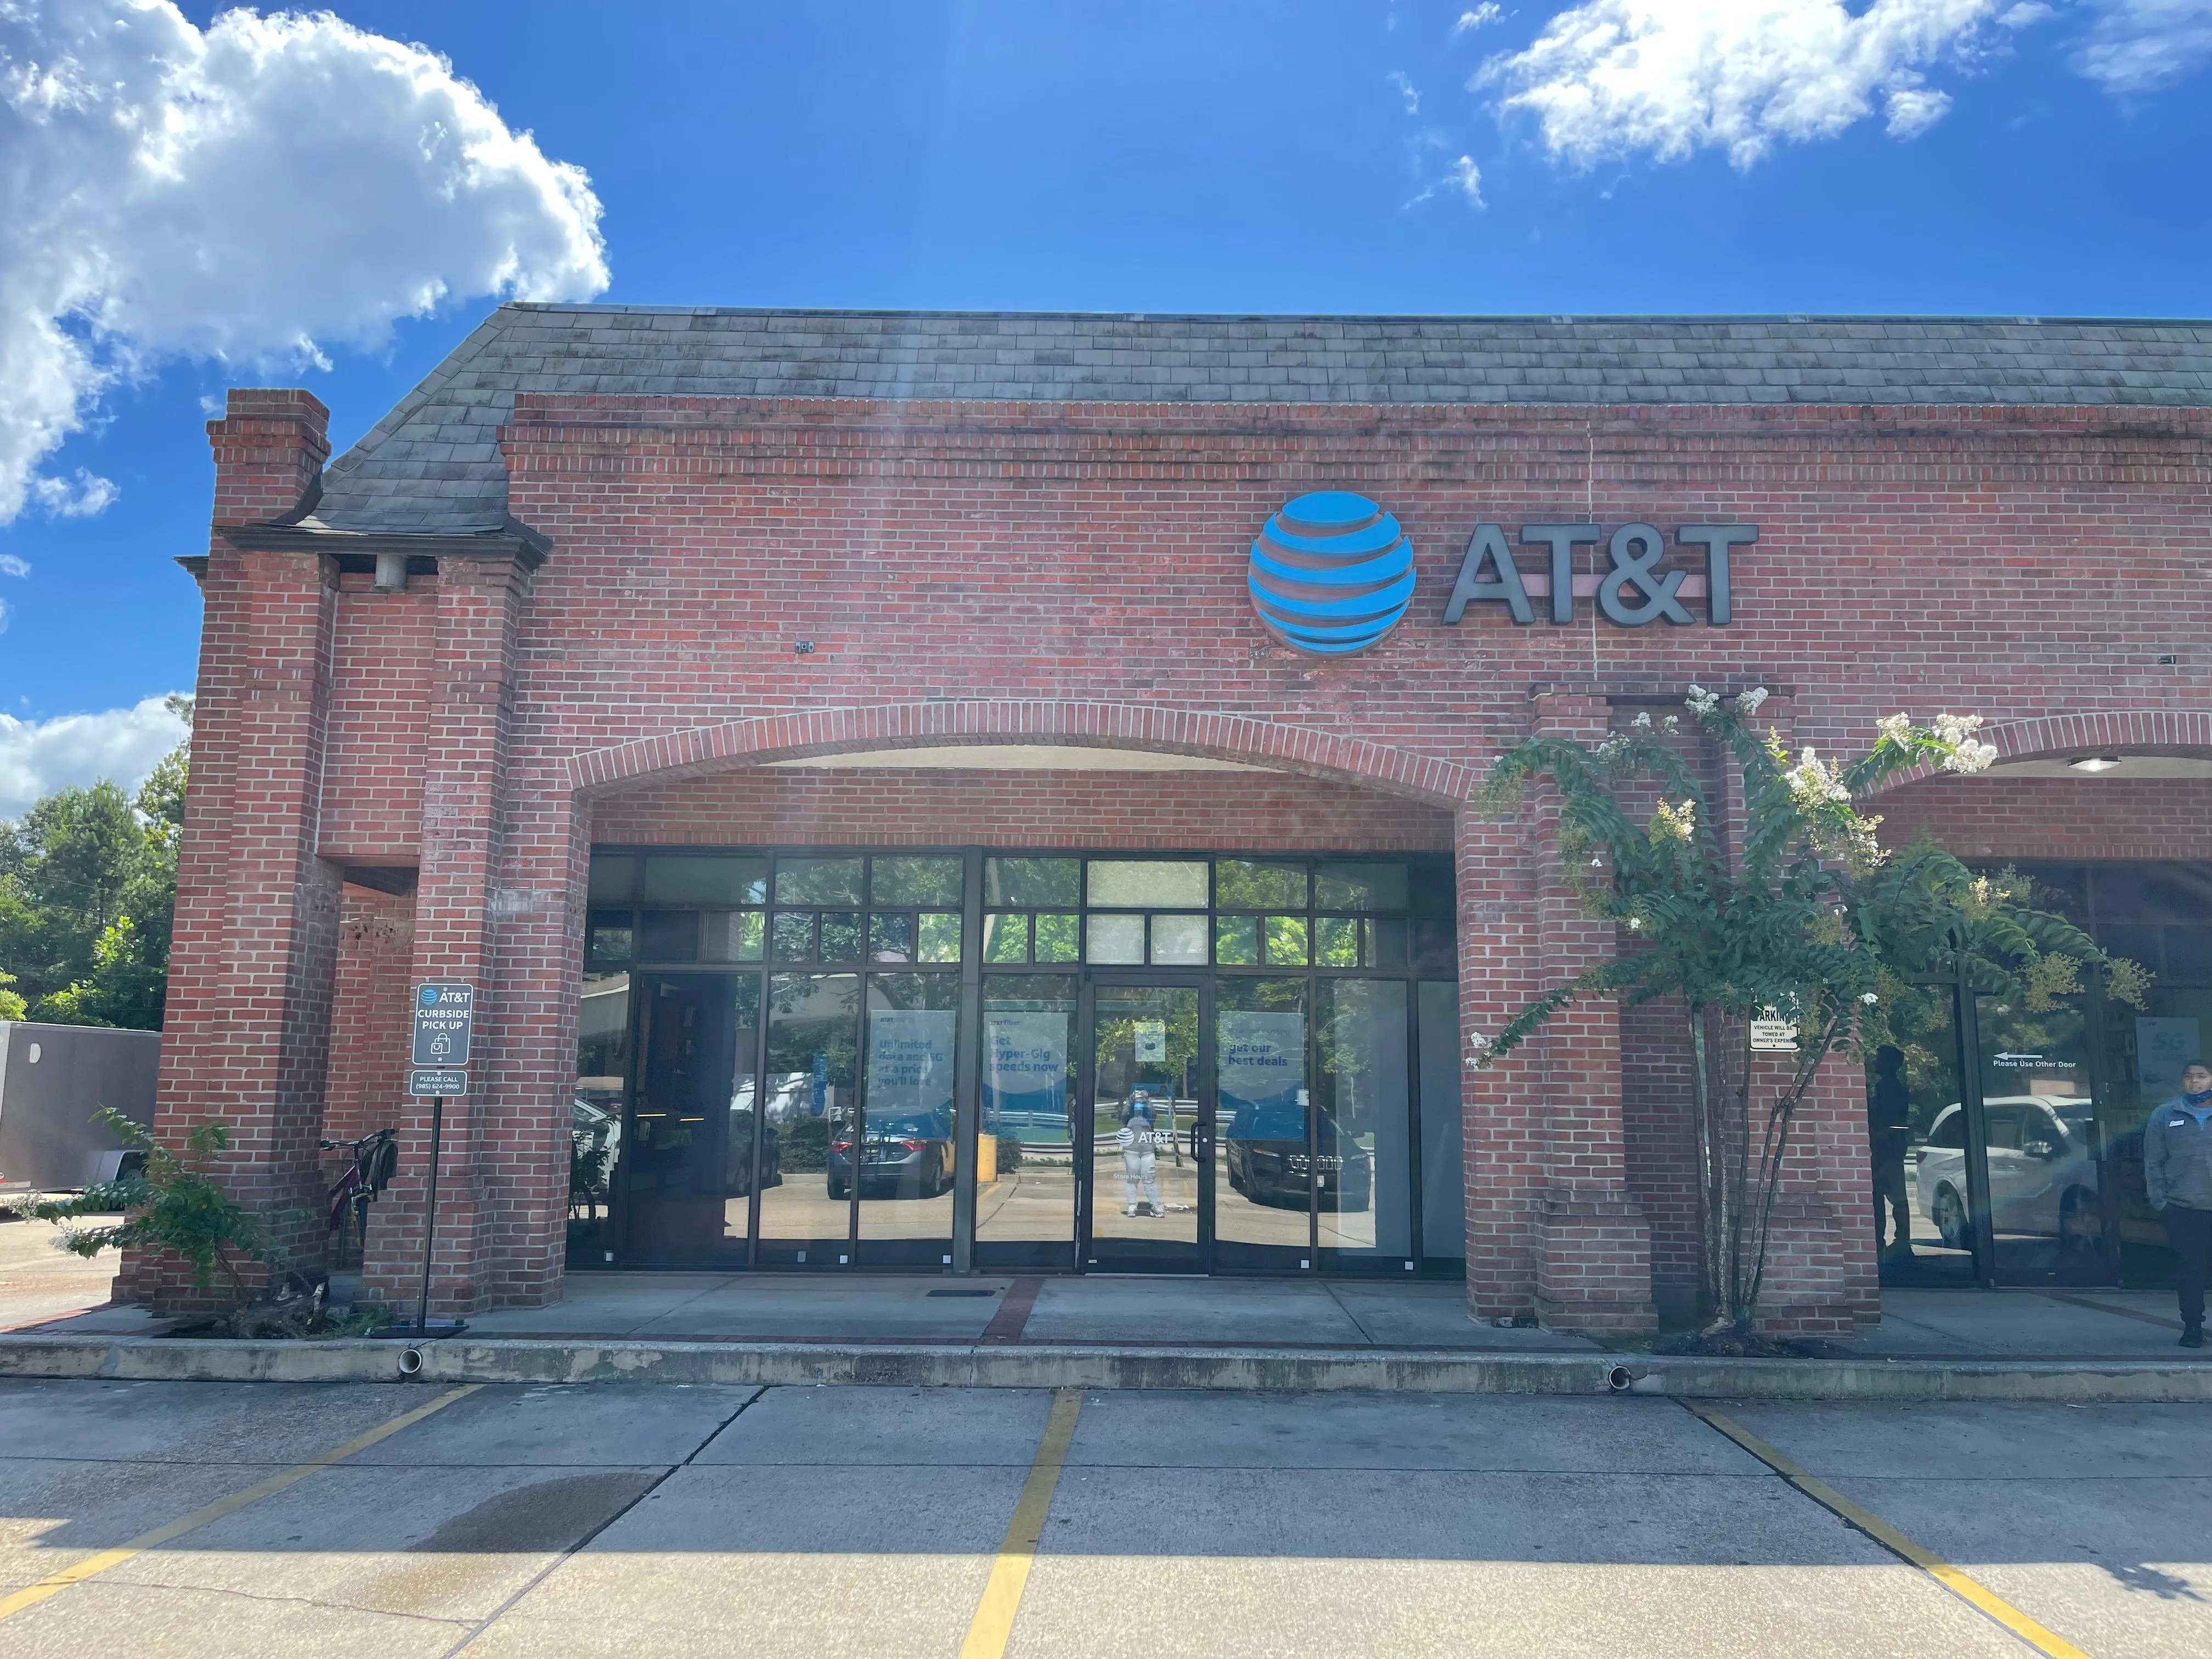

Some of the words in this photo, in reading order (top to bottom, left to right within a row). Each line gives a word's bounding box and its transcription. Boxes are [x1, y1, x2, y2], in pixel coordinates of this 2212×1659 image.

[1442, 523, 1759, 628] AT&T
[439, 992, 470, 1003] AT&T
[417, 1009, 470, 1018] CURBSIDE
[422, 1021, 446, 1030] PICK
[449, 1021, 463, 1030] UP
[879, 1039, 932, 1049] Unlimited
[2151, 1032, 2186, 1051] 5G
[1229, 1044, 1249, 1054] get
[878, 1051, 904, 1061] data
[930, 1053, 943, 1062] 5G
[1228, 1055, 1254, 1065] best
[1257, 1056, 1288, 1066] deals
[901, 1064, 927, 1075] pric
[990, 1061, 1031, 1073] speeds
[1033, 1063, 1059, 1072] now
[877, 1076, 906, 1087] you'll
[910, 1076, 932, 1086] loe
[1138, 1132, 1171, 1144] AT&T
